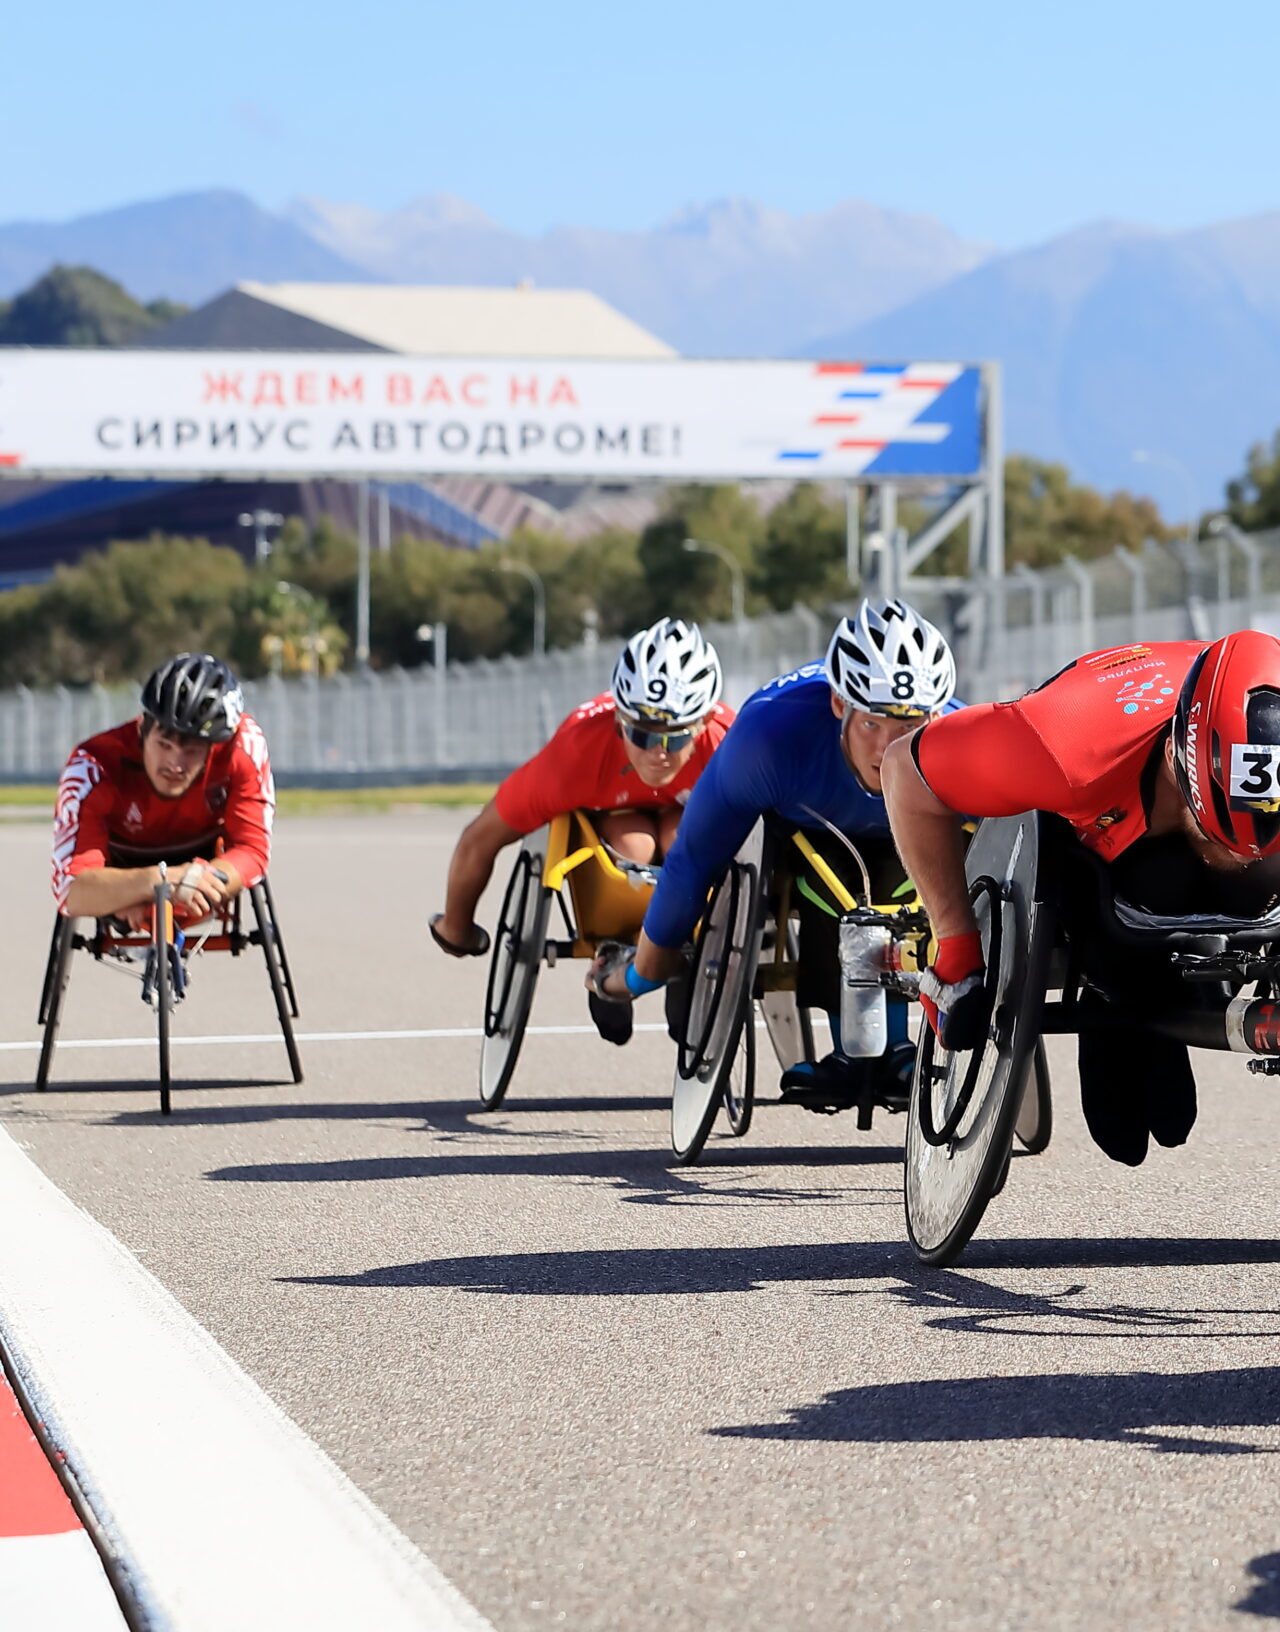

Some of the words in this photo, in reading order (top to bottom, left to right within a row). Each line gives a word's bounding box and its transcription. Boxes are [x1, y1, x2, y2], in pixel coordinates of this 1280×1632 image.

[203, 372, 364, 408] ЖДЕМ
[386, 374, 487, 406] ВАС
[509, 377, 578, 406] НА
[96, 417, 312, 451] СИРИУС
[332, 420, 683, 456] АВТОДРОМЕ!
[647, 679, 668, 702] 9
[892, 671, 915, 699] 8
